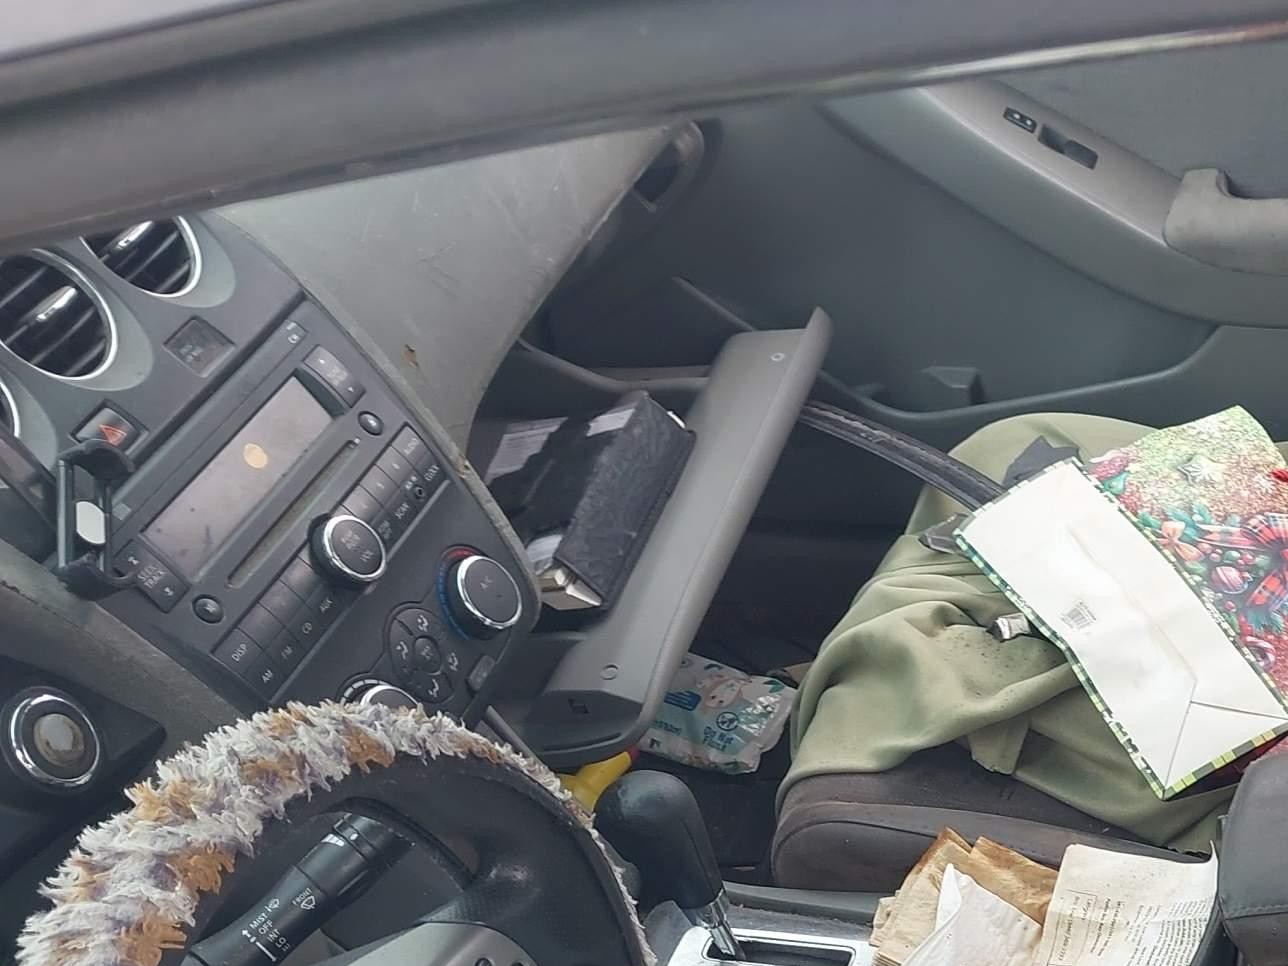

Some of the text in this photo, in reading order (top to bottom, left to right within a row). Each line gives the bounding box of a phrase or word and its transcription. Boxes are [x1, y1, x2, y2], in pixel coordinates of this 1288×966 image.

[231, 643, 247, 663] DISP
[261, 668, 274, 684] AM
[291, 887, 313, 906] FRONT
[248, 911, 269, 930] MIST
[258, 919, 273, 935] OFF
[266, 928, 281, 943] INT
[275, 936, 287, 948] LO
